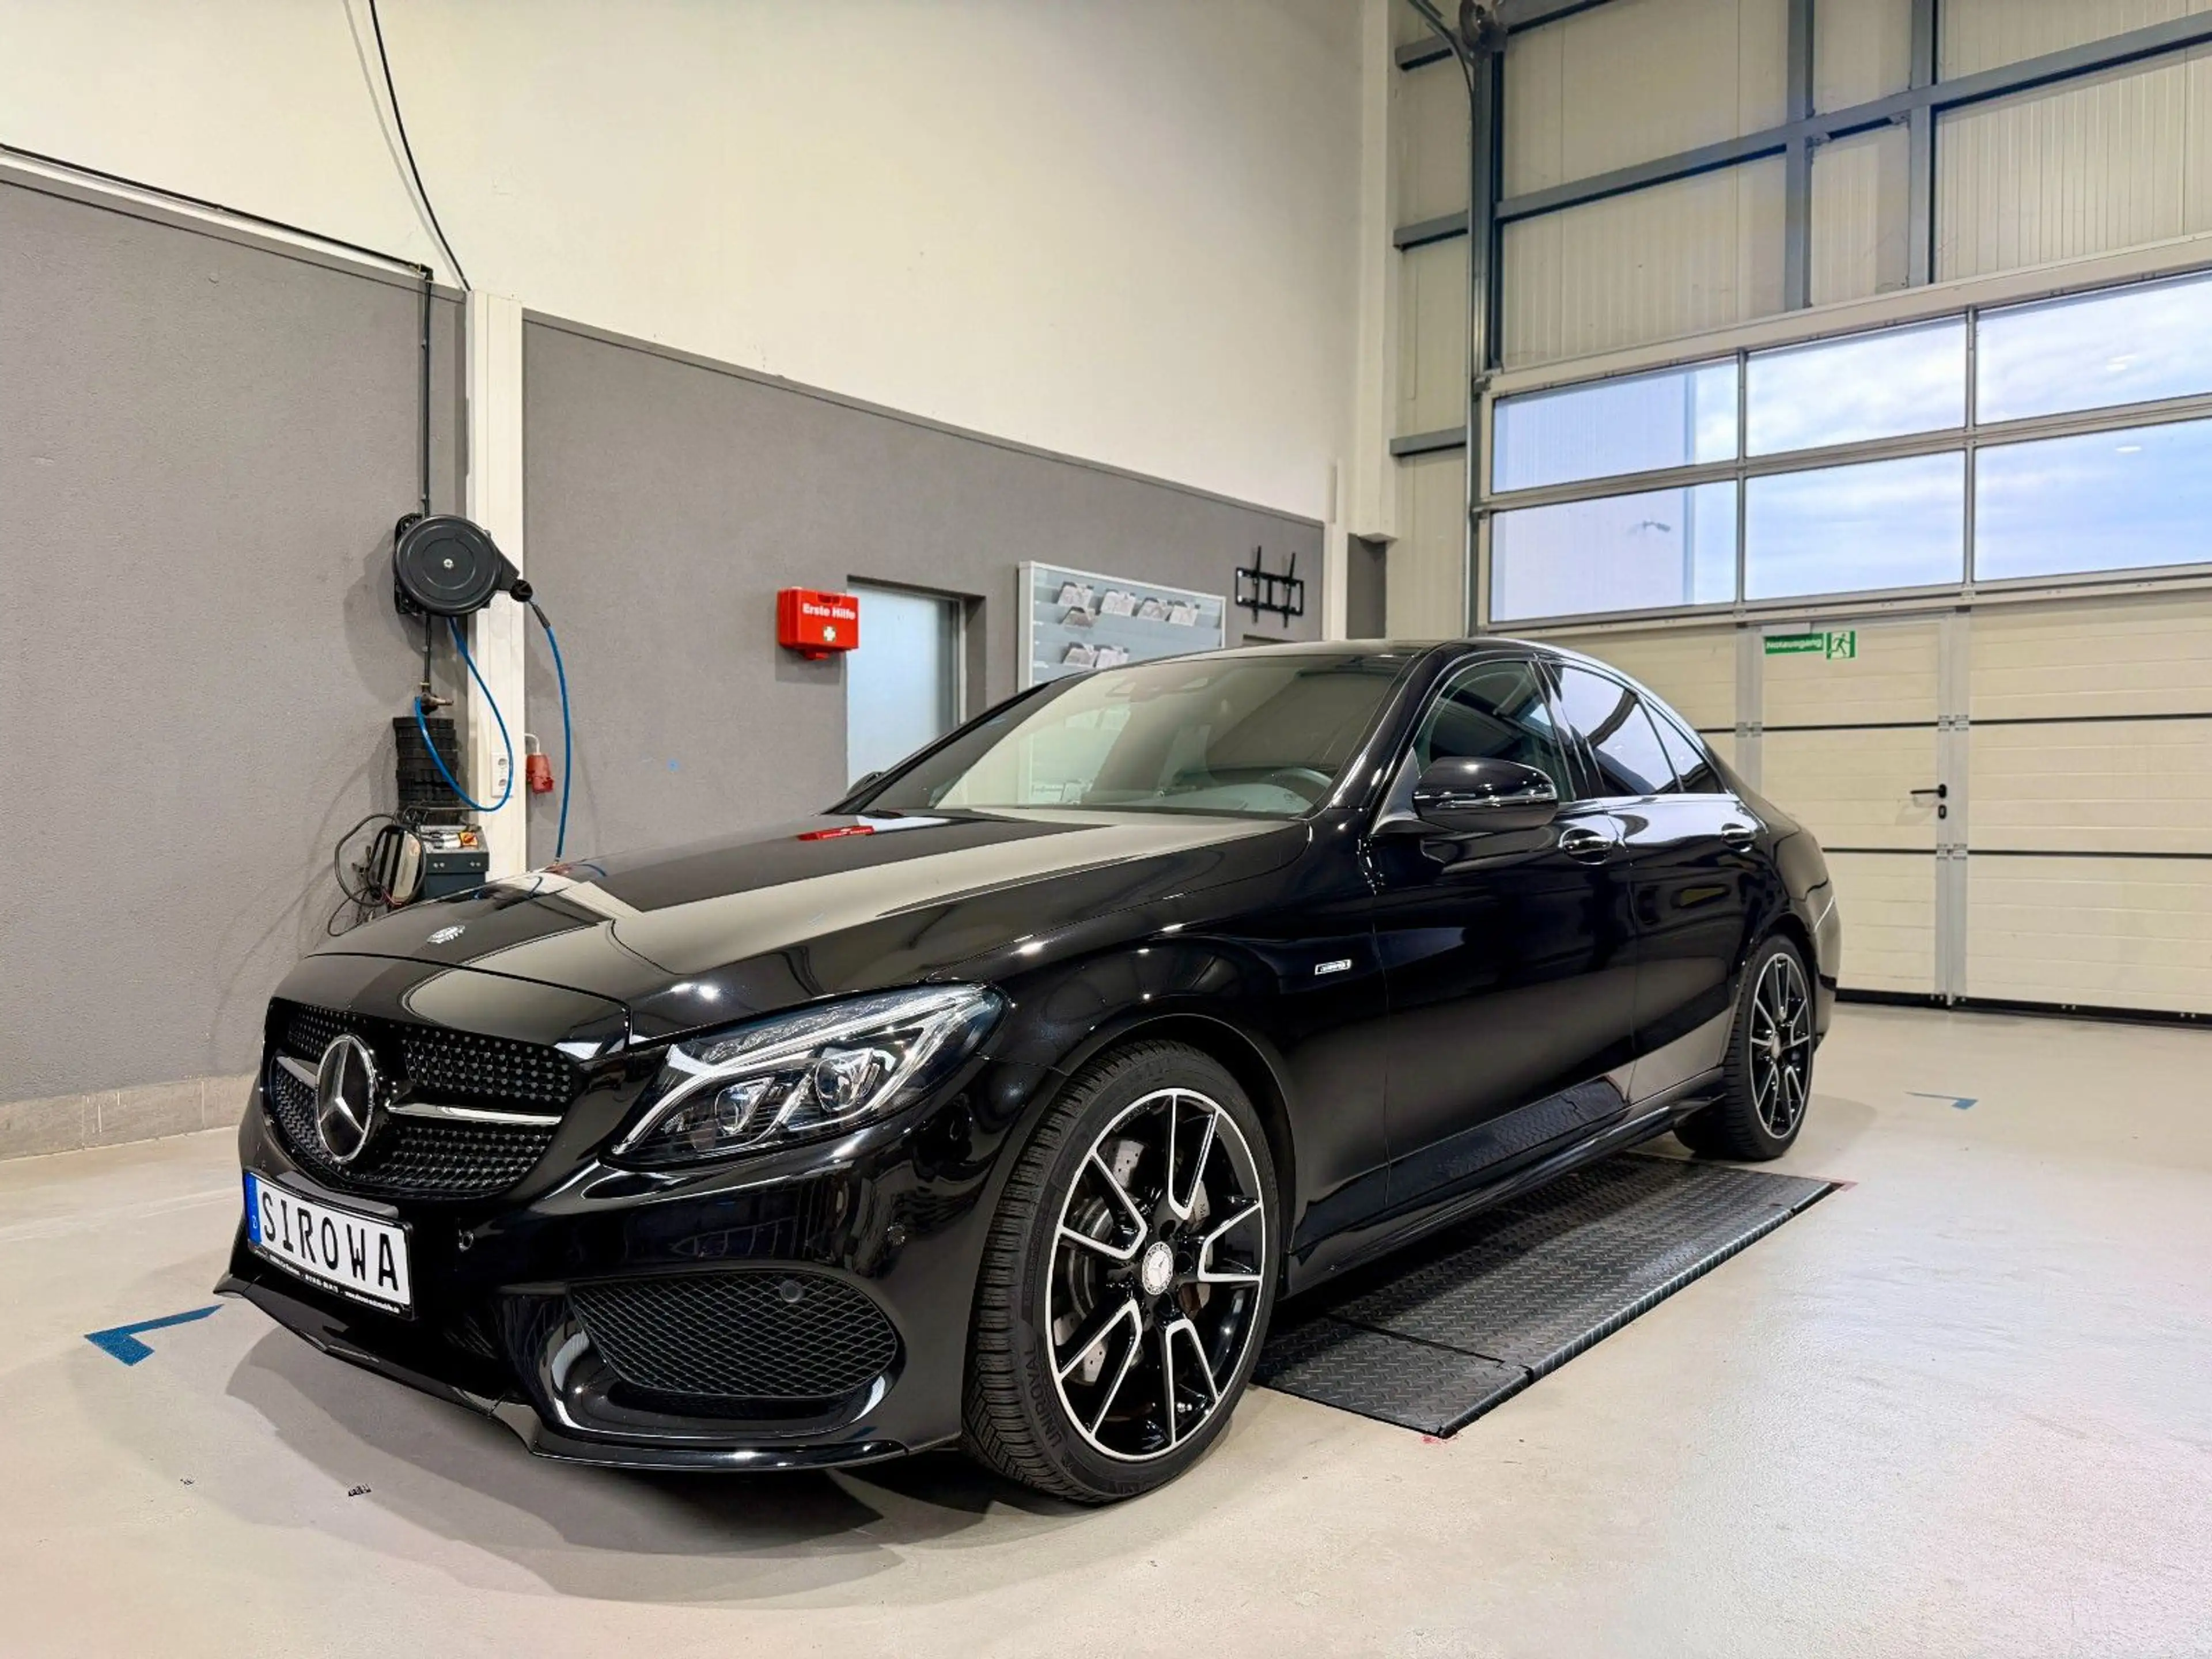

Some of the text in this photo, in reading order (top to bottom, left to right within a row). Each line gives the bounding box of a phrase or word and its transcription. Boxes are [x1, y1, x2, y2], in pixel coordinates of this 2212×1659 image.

[803, 603, 856, 620] Erste Hilfe
[262, 1191, 399, 1291] SIROWA
